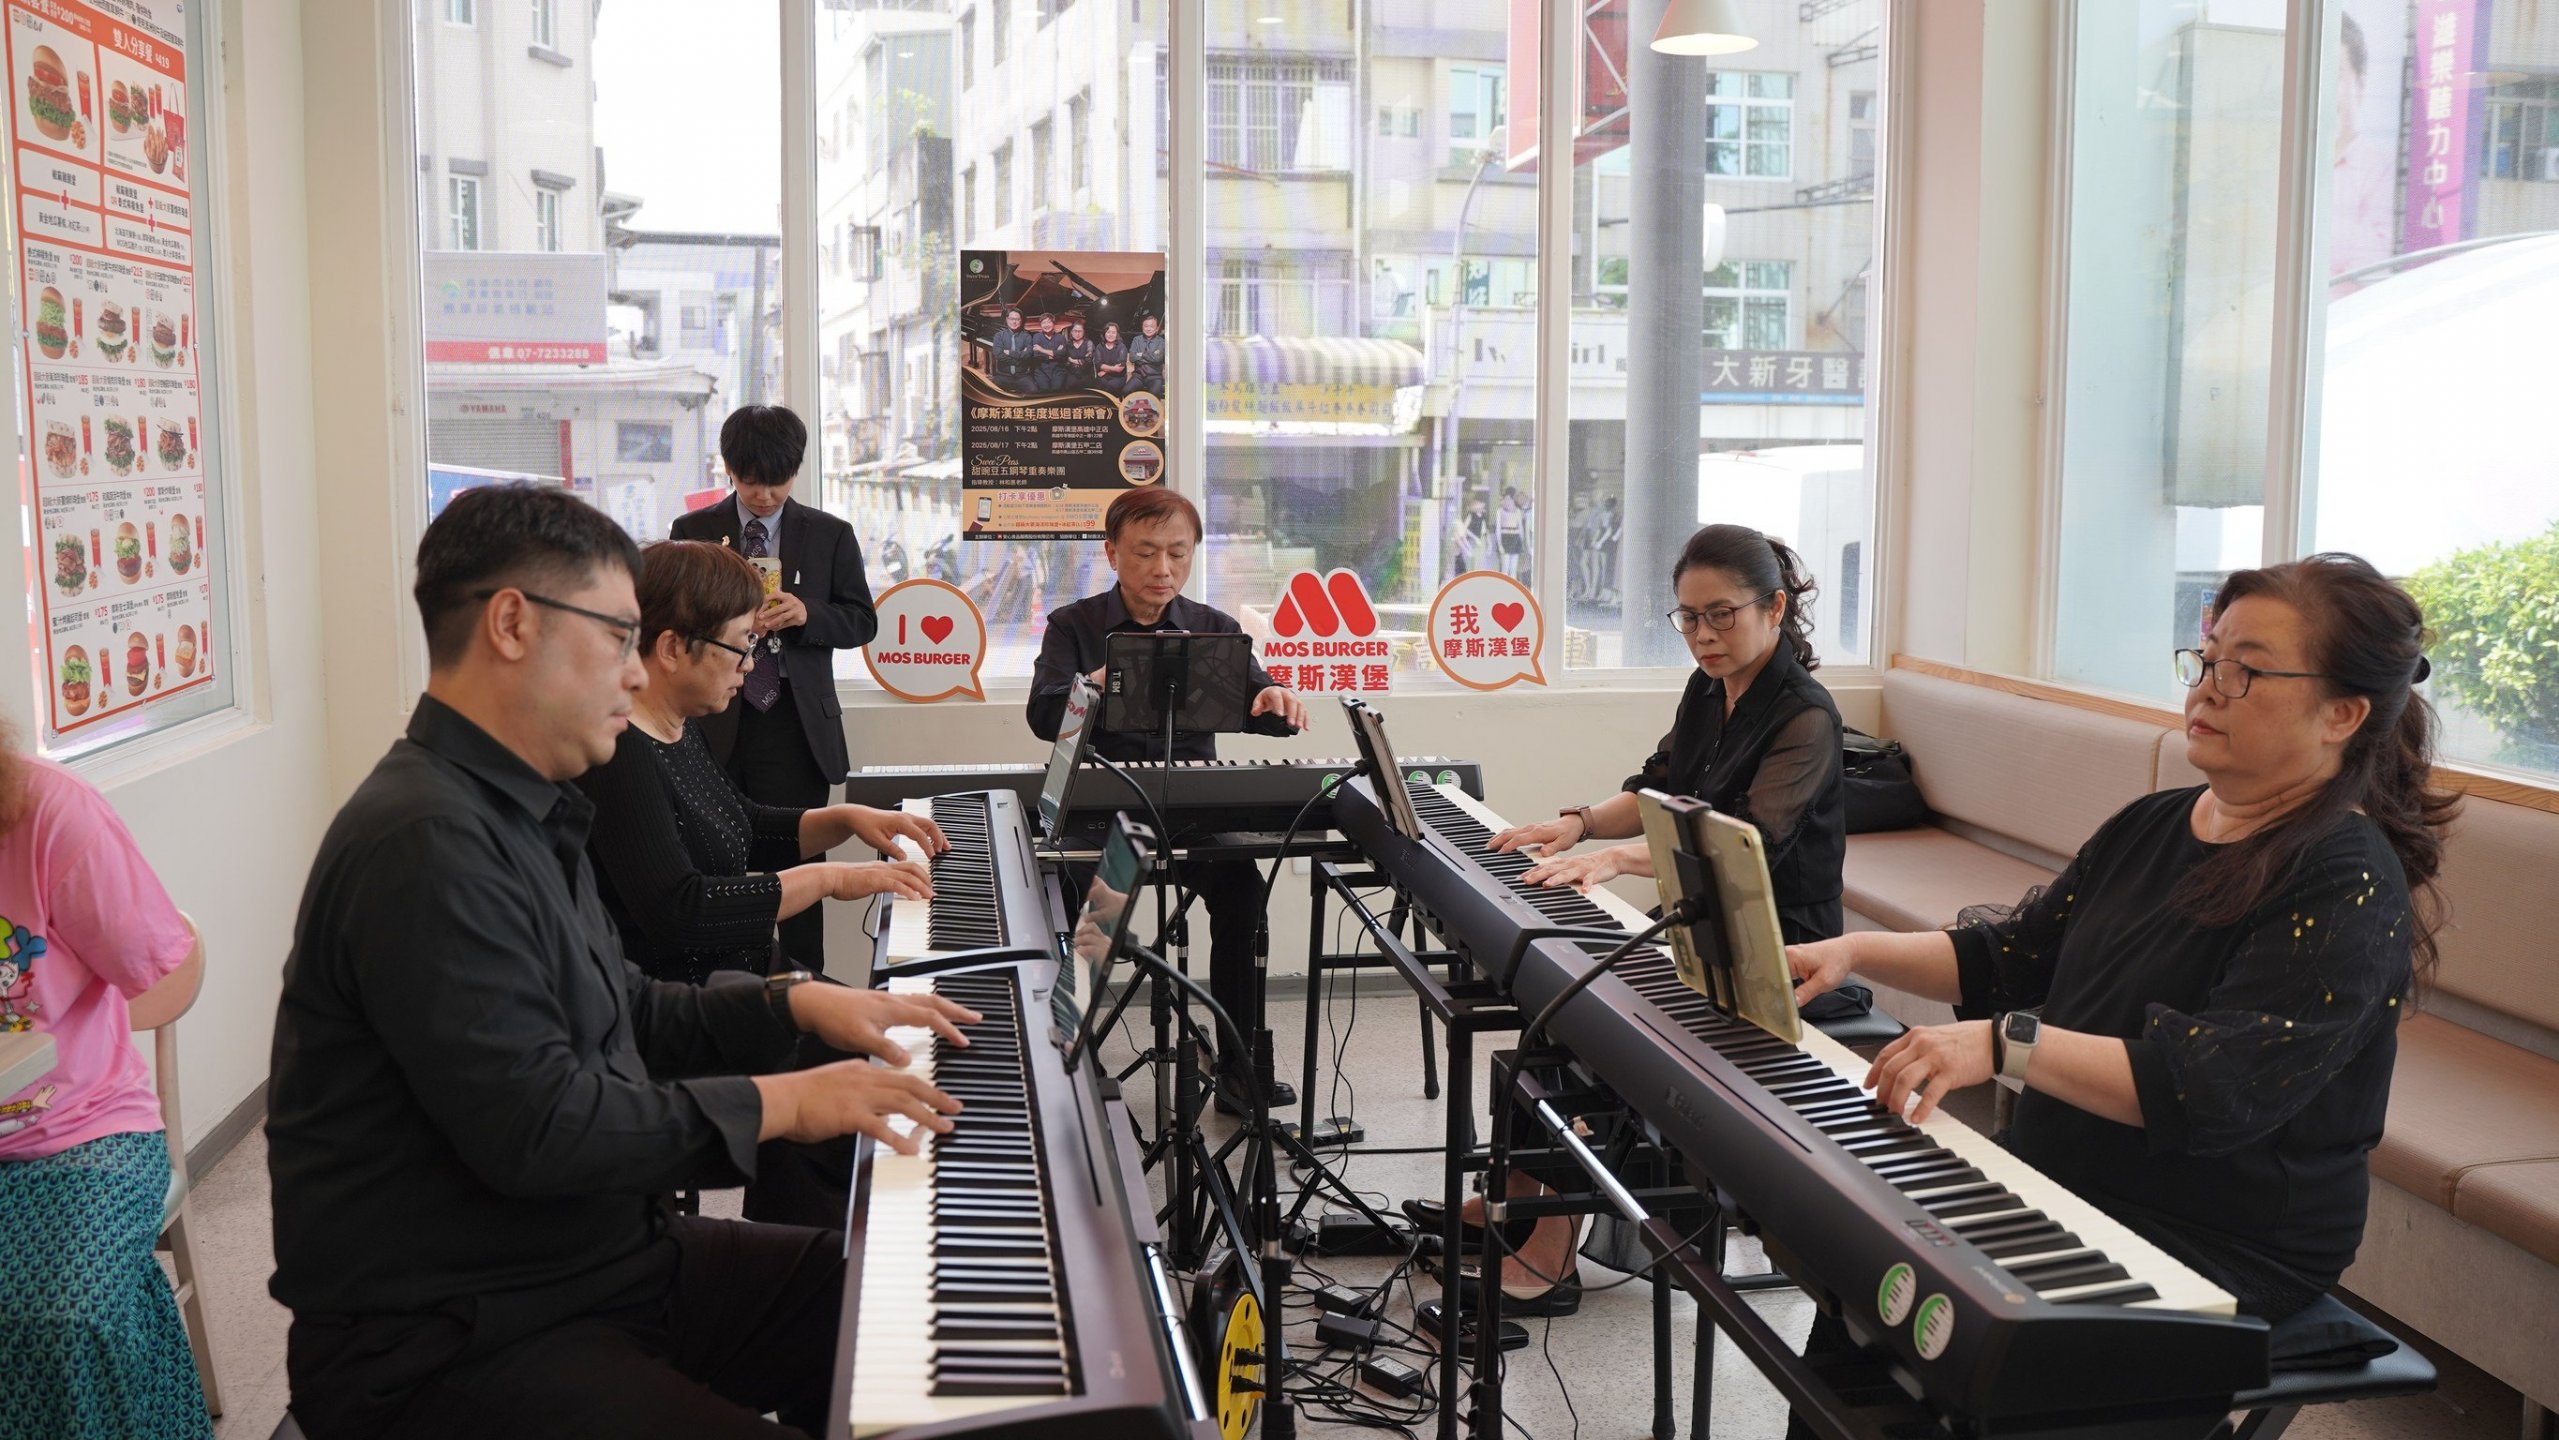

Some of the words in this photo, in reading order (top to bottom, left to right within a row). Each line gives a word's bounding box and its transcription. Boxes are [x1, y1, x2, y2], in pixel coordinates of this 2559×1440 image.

[112, 28, 153, 64] 雙人分享餐
[471, 404, 507, 414] YAMAHA
[970, 407, 1114, 420] 《摩斯漢堡年度巡迴音樂會》
[998, 492, 1046, 501] 打卡享優惠
[1450, 604, 1480, 635] 我
[899, 614, 906, 646] I
[1264, 641, 1310, 658] MOS
[1312, 641, 1389, 658] BURGER
[1443, 636, 1531, 659] 摩斯漢堡
[877, 652, 912, 664] MOS
[913, 653, 971, 665] BURGER
[1266, 664, 1390, 692] 摩斯漢堡
